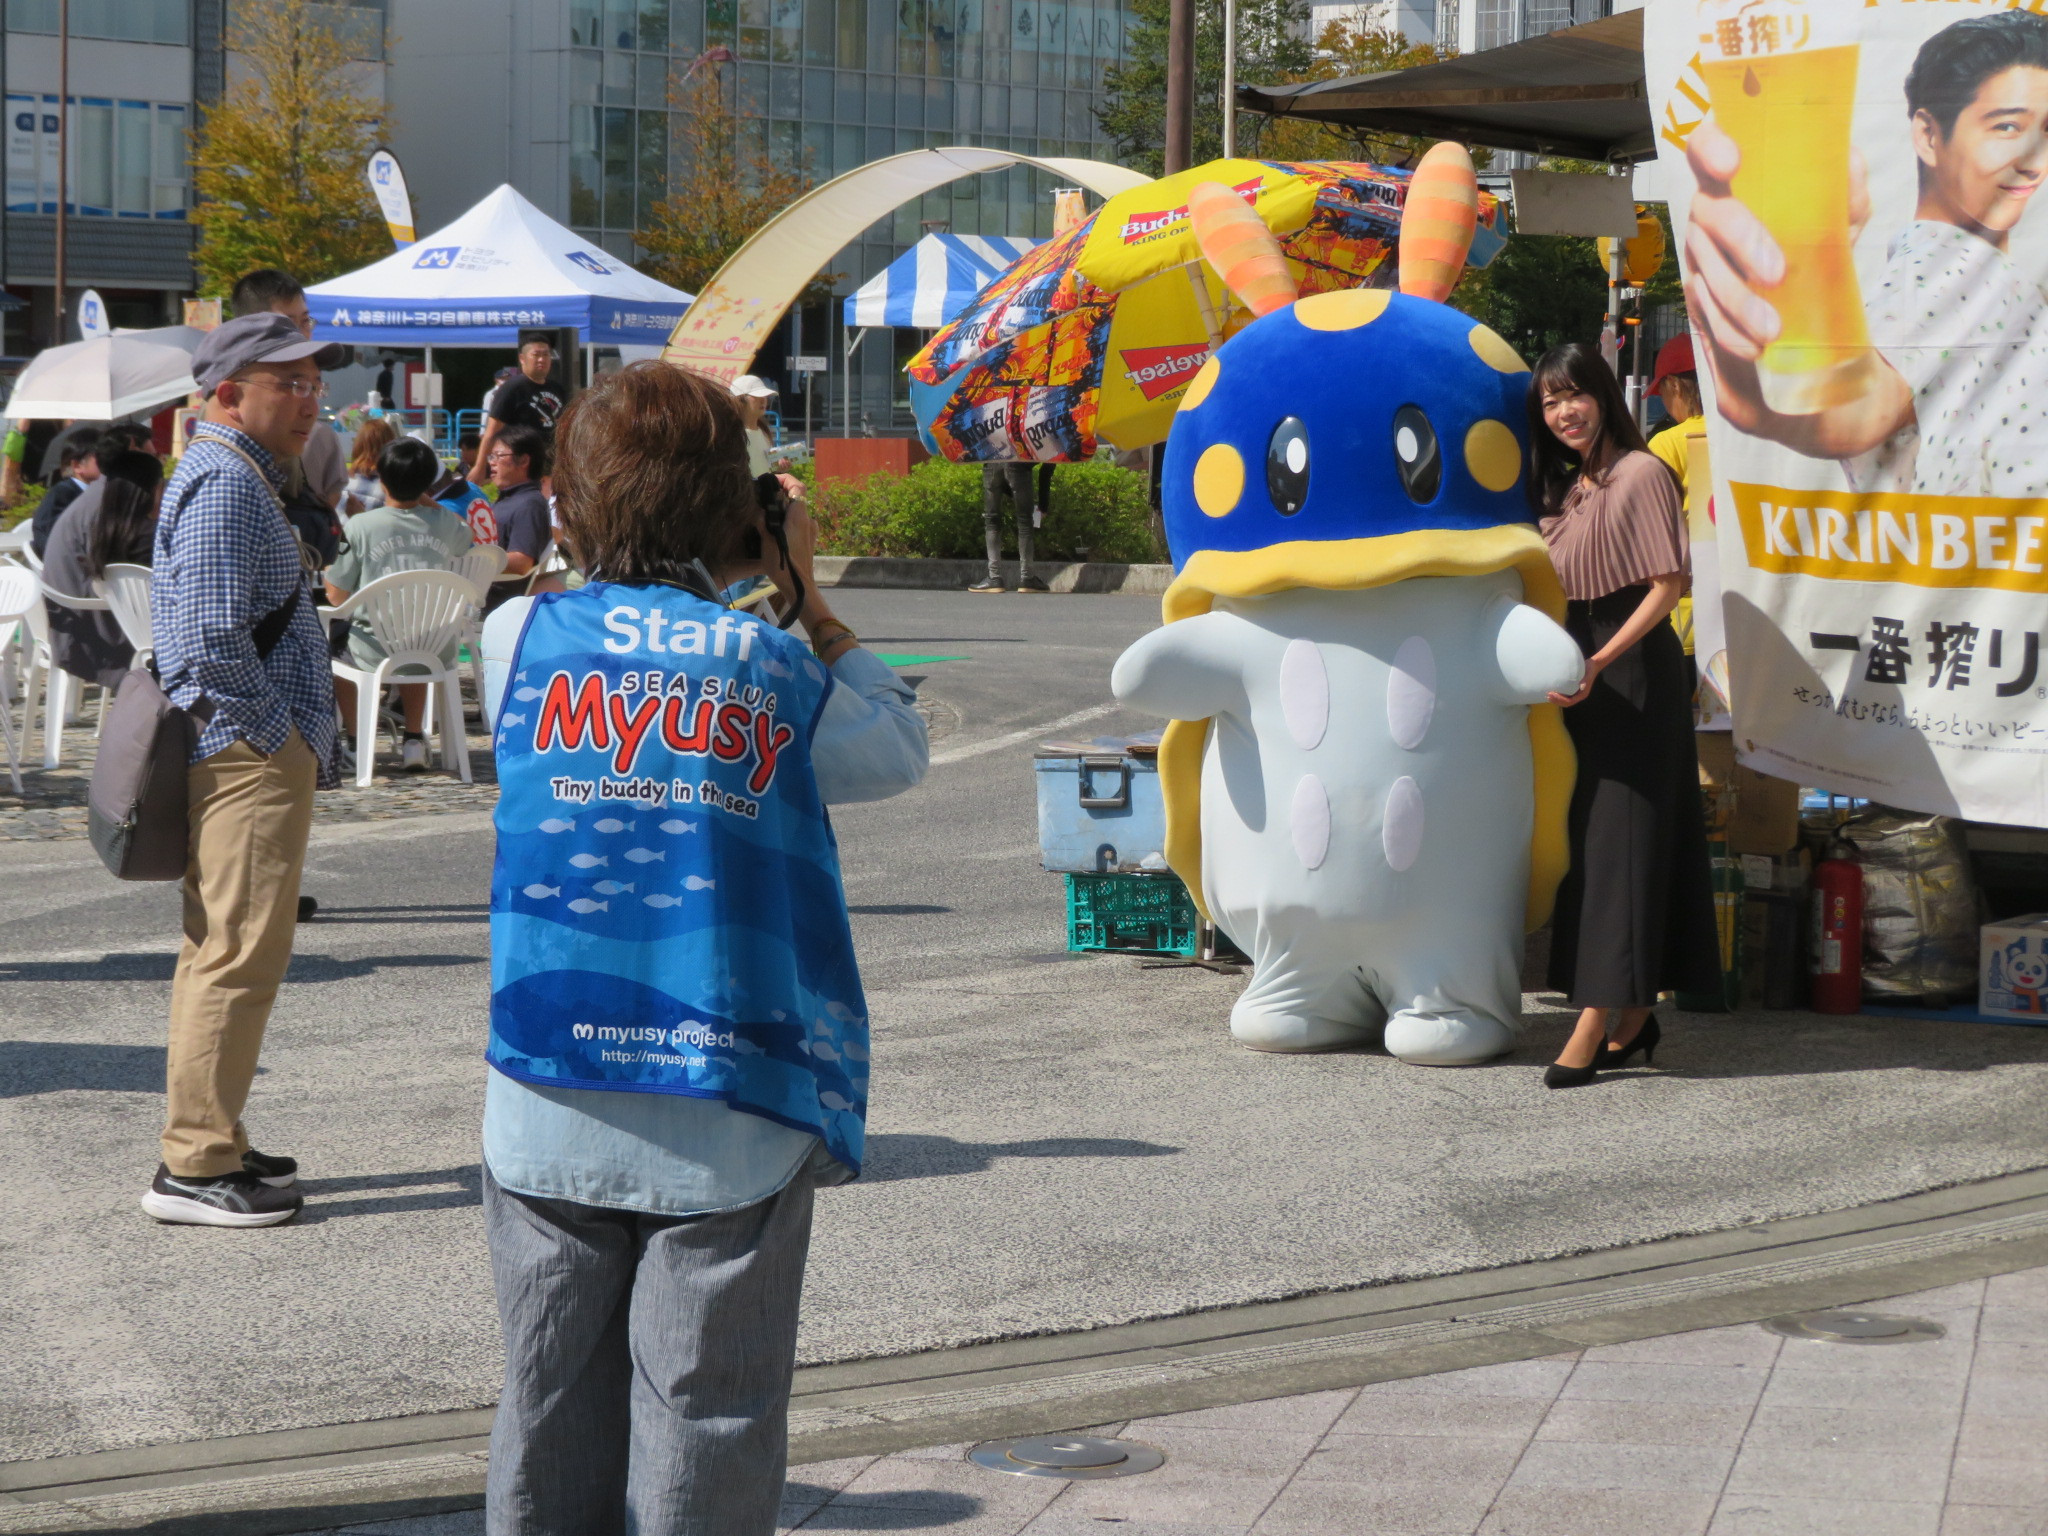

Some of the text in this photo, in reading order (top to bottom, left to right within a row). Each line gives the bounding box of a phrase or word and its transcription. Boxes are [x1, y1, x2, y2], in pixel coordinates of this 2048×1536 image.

[1700, 13, 1811, 57] 一番搾り
[357, 309, 547, 326] 神奈川トヨタ自動車株式会社
[1760, 502, 2045, 573] KIRIN BEE
[603, 605, 760, 662] Staff
[1809, 616, 2040, 698] 一番搾り
[622, 672, 777, 713] SEA SLUG
[535, 672, 792, 793] Myusy
[552, 778, 757, 818] Tiny buddy in th sea
[597, 1025, 735, 1050] myusy project
[602, 1049, 707, 1068] http://myusy.net
